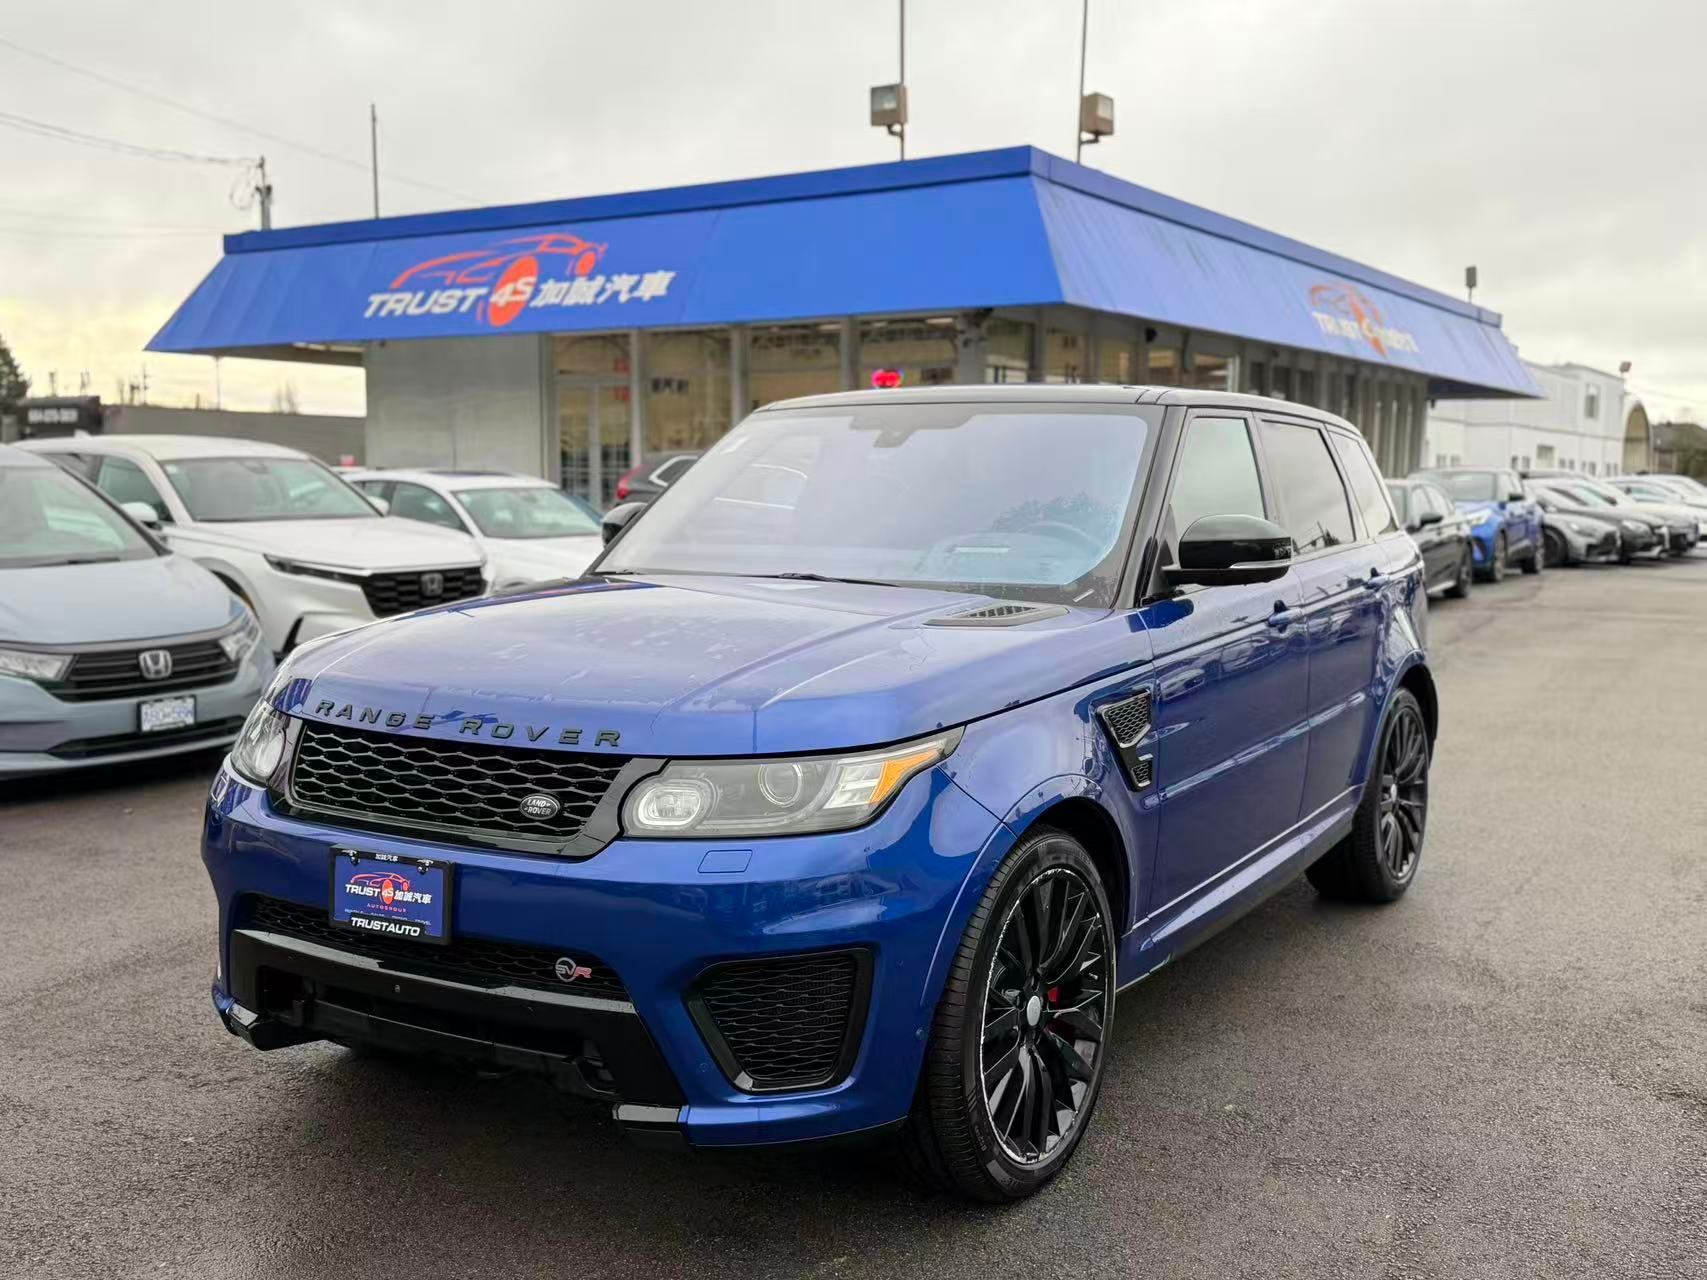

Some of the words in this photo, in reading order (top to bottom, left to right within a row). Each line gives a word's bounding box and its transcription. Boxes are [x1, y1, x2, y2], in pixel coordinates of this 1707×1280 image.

[363, 287, 488, 319] TRUST
[315, 699, 434, 730] RANGE
[459, 717, 621, 747] ROVER
[527, 798, 547, 808] LAND
[527, 806, 552, 816] ROVER
[345, 884, 381, 898] TRUST
[350, 917, 421, 937] TRUSTAUTO
